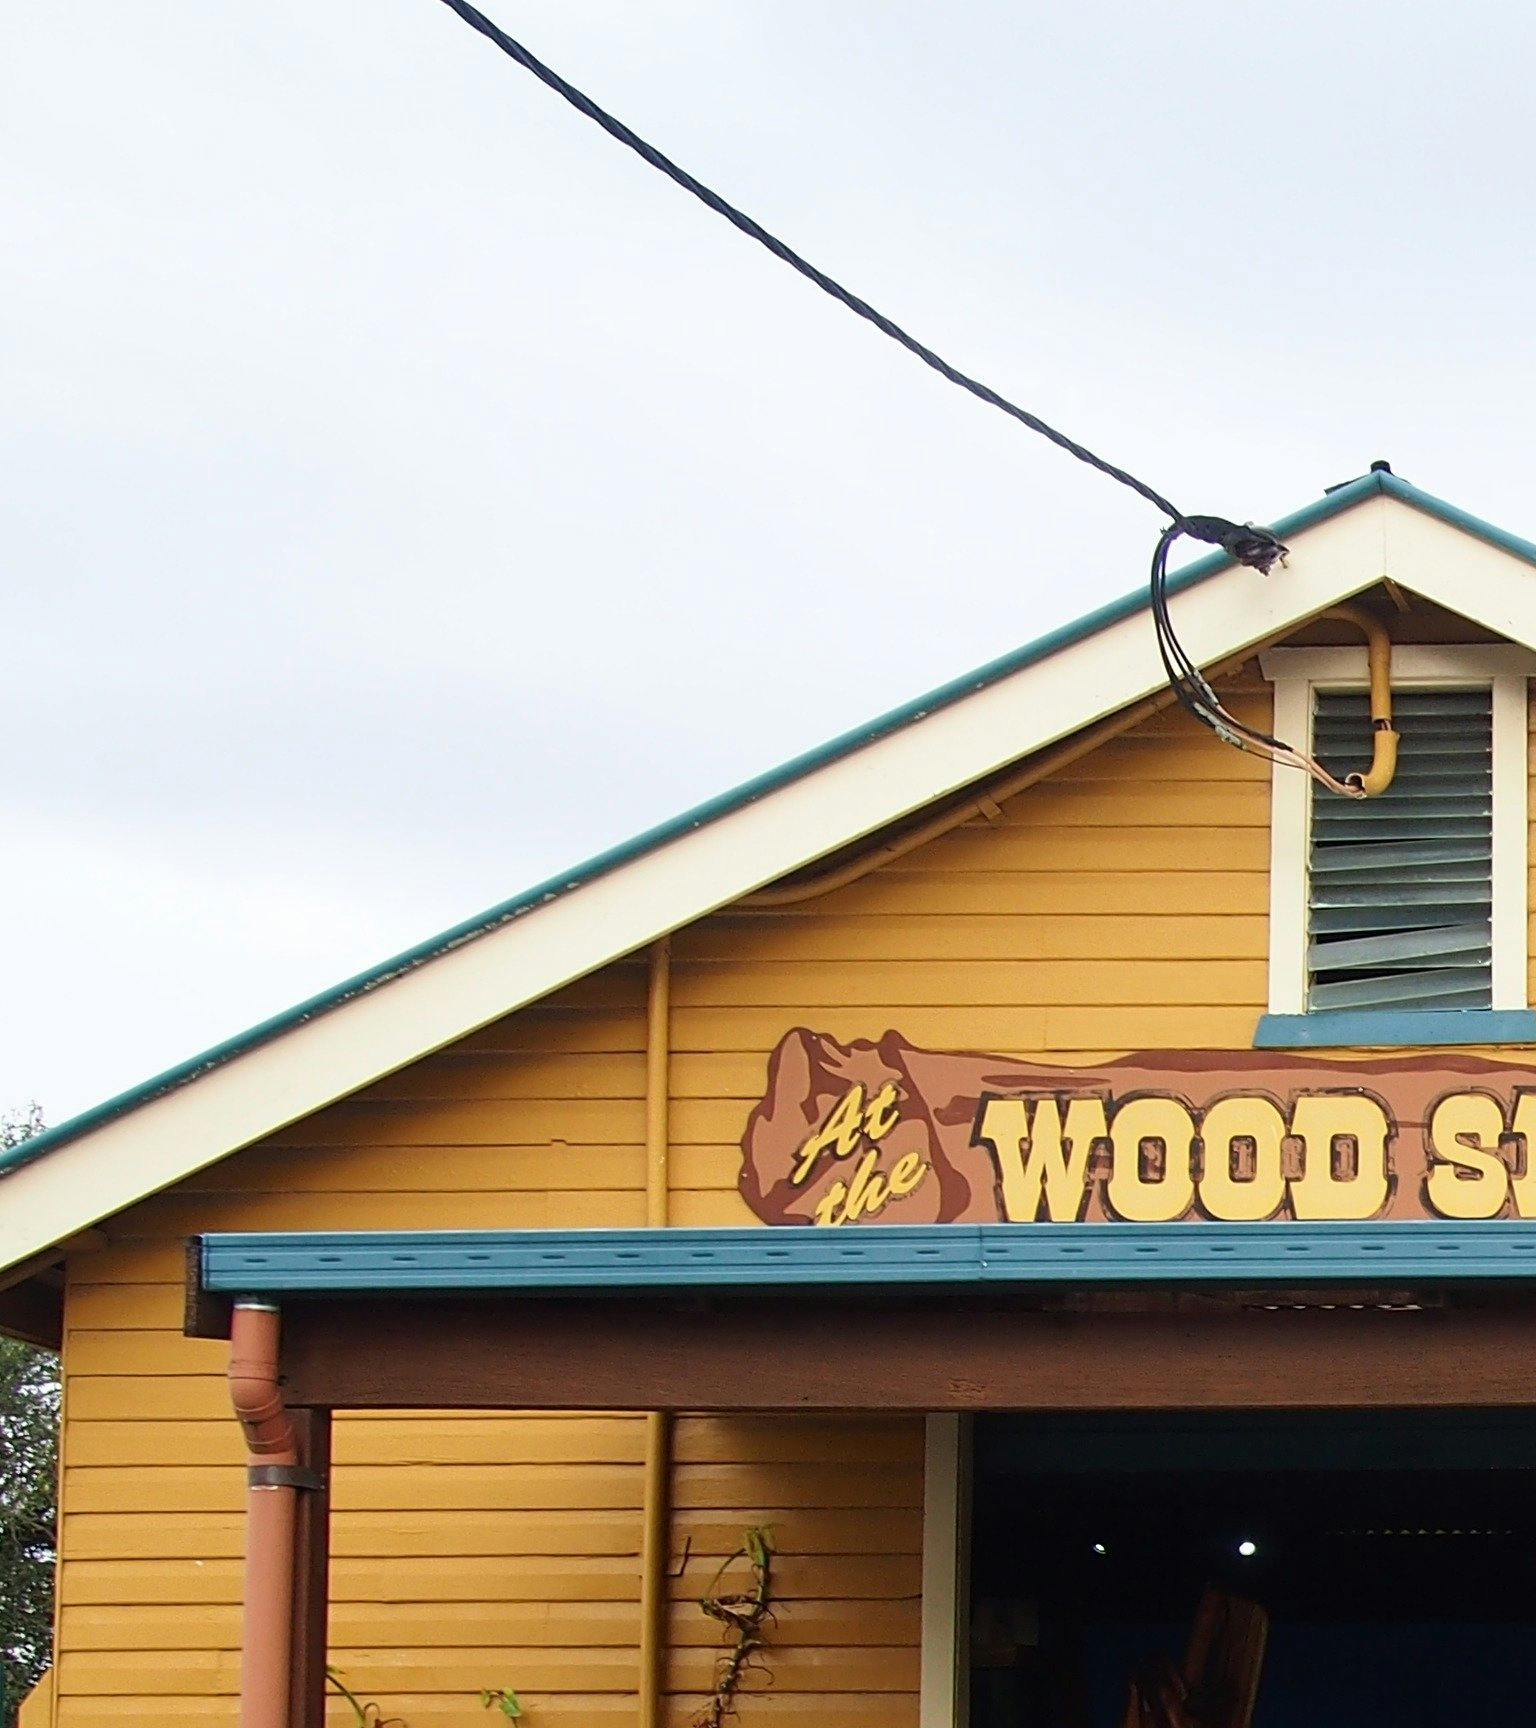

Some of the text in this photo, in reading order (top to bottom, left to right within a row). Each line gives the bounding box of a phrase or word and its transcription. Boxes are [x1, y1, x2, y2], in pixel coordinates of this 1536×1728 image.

[790, 1082, 899, 1185] At
[978, 1095, 1392, 1223] WOOD
[814, 1148, 927, 1226] the
